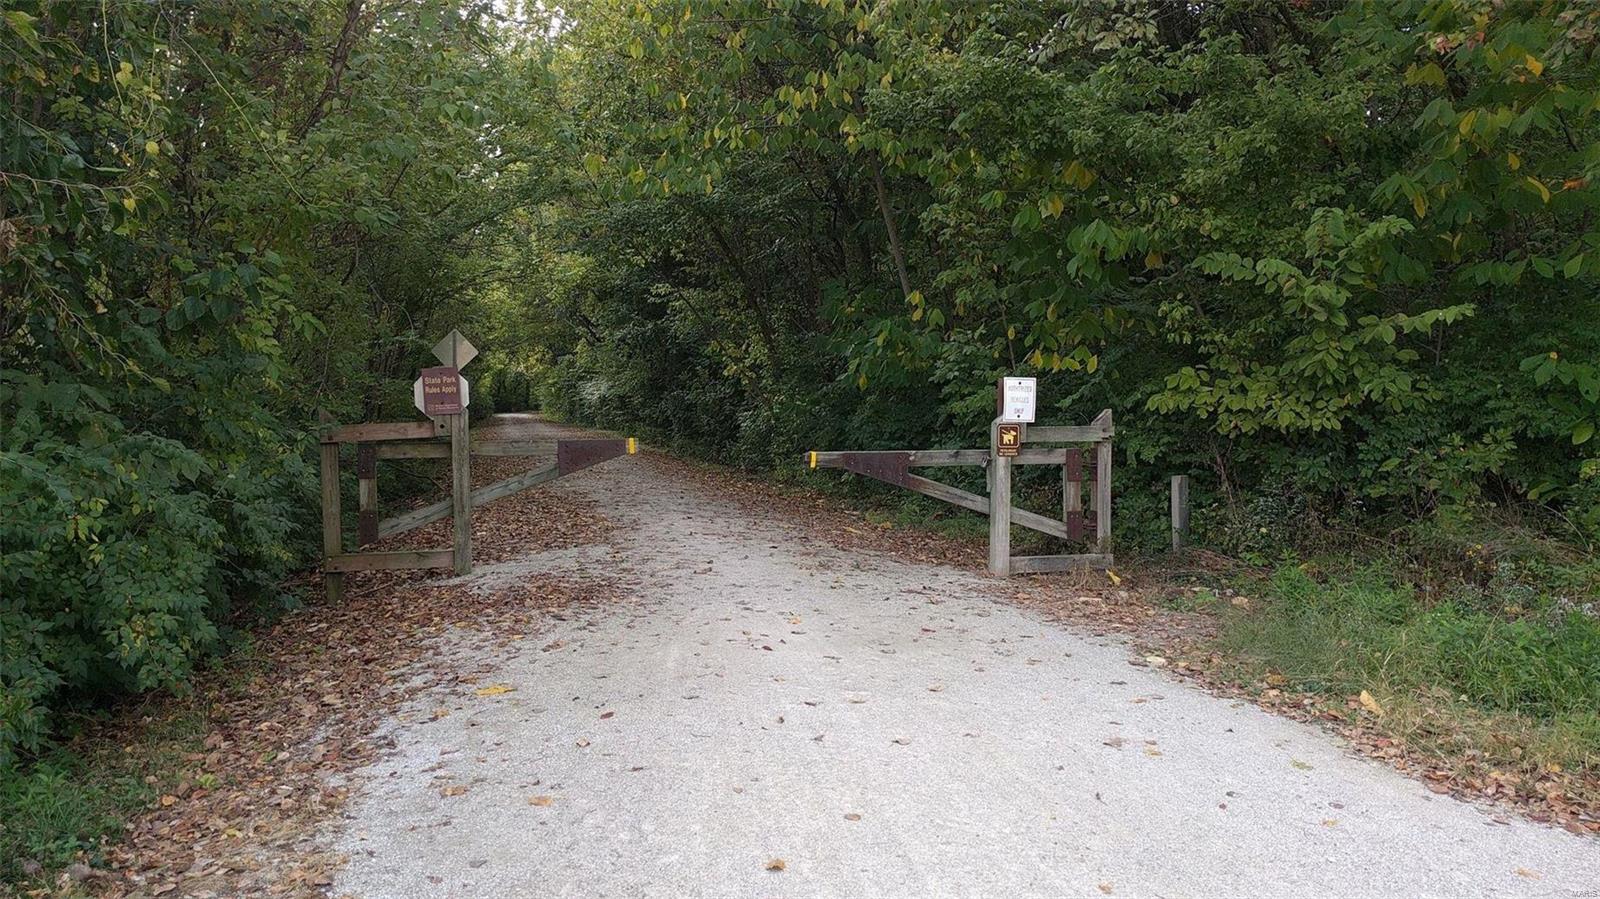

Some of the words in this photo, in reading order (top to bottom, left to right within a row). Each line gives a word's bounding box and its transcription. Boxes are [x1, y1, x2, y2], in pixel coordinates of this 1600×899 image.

[424, 376, 441, 384] State
[442, 376, 457, 384] Park
[425, 386, 441, 394] Rules
[442, 386, 457, 395] Apply
